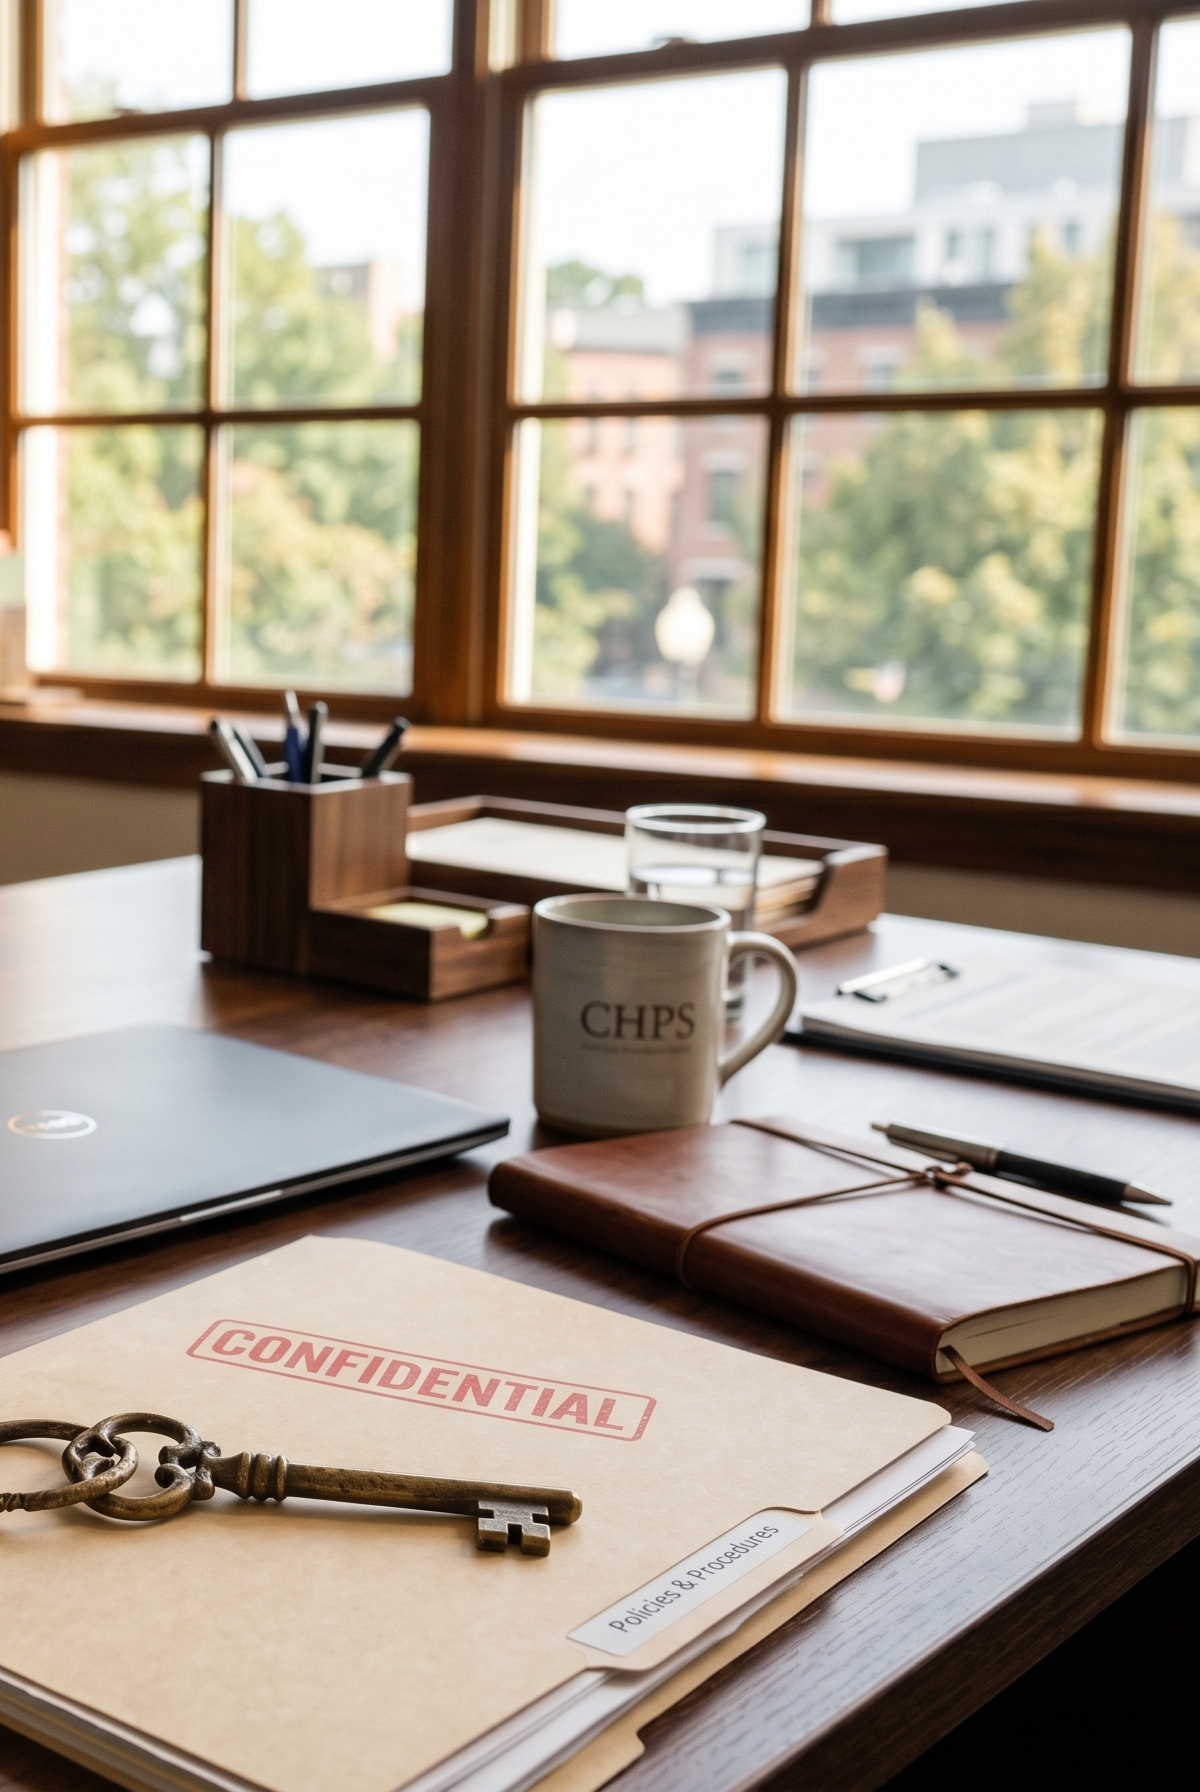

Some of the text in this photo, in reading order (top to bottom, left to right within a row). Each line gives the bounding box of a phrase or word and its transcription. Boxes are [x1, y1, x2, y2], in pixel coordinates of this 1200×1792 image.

[580, 1000, 696, 1041] CHPS
[210, 1328, 626, 1433] CONFIDENTIAL
[608, 1524, 779, 1633] Policies & Procedures
